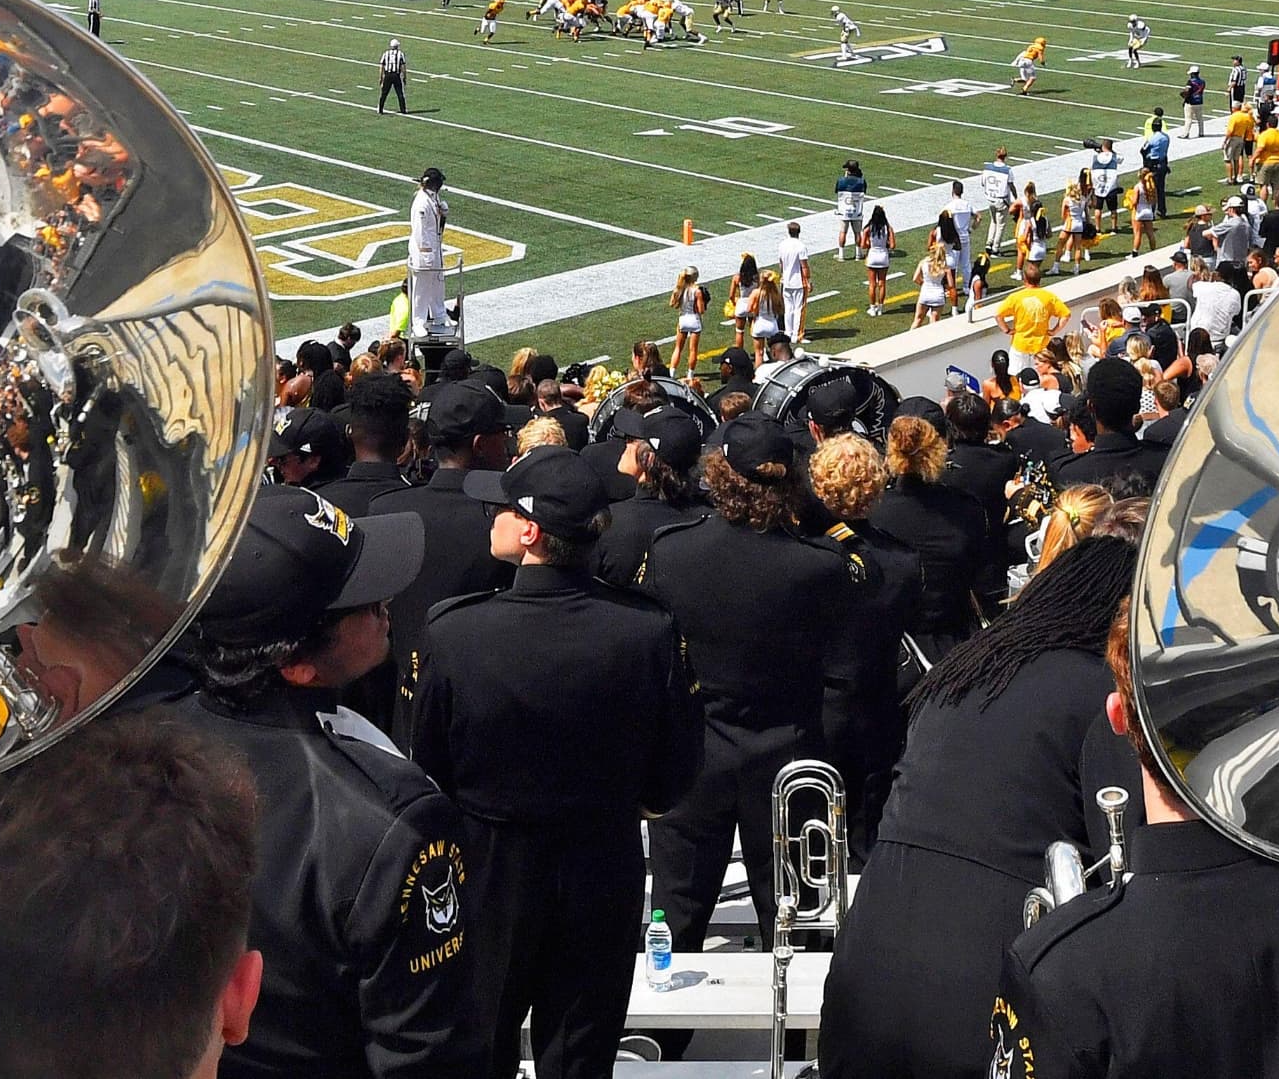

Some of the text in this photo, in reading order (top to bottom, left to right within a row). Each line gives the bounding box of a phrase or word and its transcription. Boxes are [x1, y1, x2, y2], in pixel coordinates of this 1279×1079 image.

[673, 117, 796, 139] 10
[409, 931, 464, 974] UNIVERS
[1019, 1036, 1036, 1079] STA
